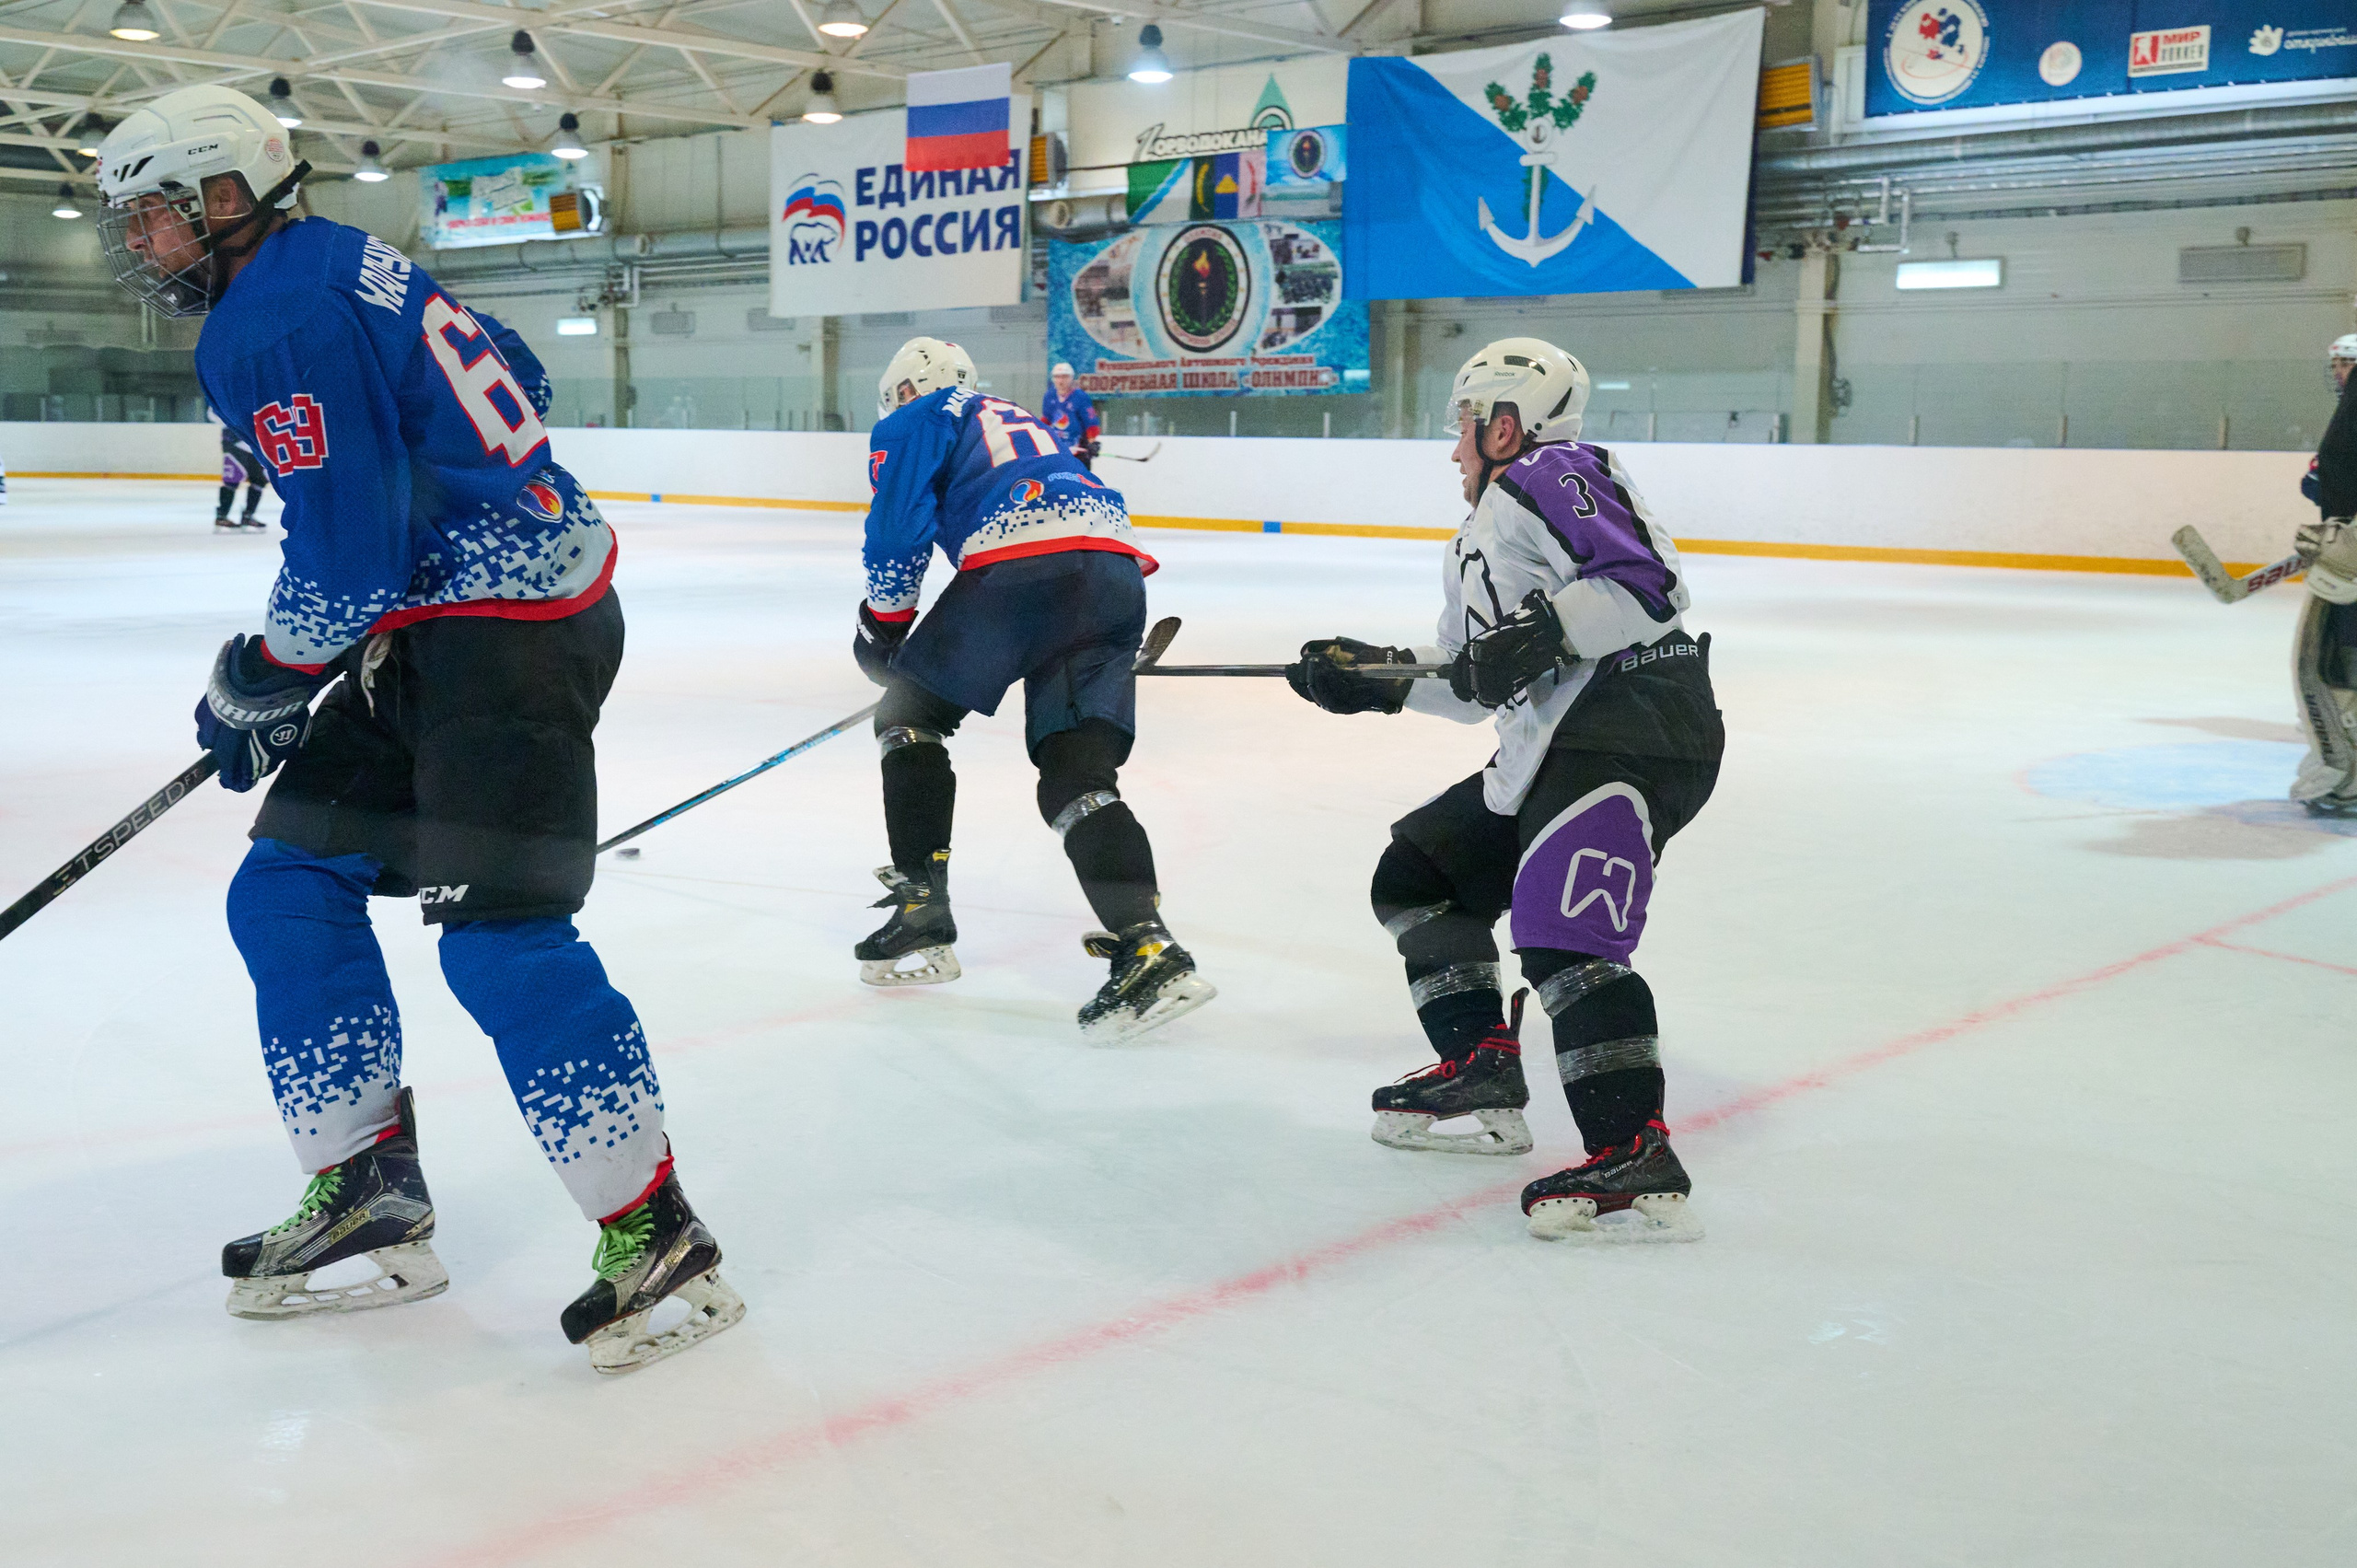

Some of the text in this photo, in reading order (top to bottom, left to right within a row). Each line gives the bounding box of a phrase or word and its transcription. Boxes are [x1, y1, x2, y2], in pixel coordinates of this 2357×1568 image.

[2163, 31, 2201, 45] МИР
[187, 143, 219, 156] CCM
[855, 148, 1022, 210] ЕДИНАЯ
[855, 204, 1021, 262] РОССИЯ
[422, 292, 550, 470] 6
[1182, 371, 1238, 389] ШКОЛА
[253, 393, 330, 478] 69
[1559, 472, 1598, 519] 3
[209, 683, 304, 723] RRIOR
[418, 884, 470, 904] CM
